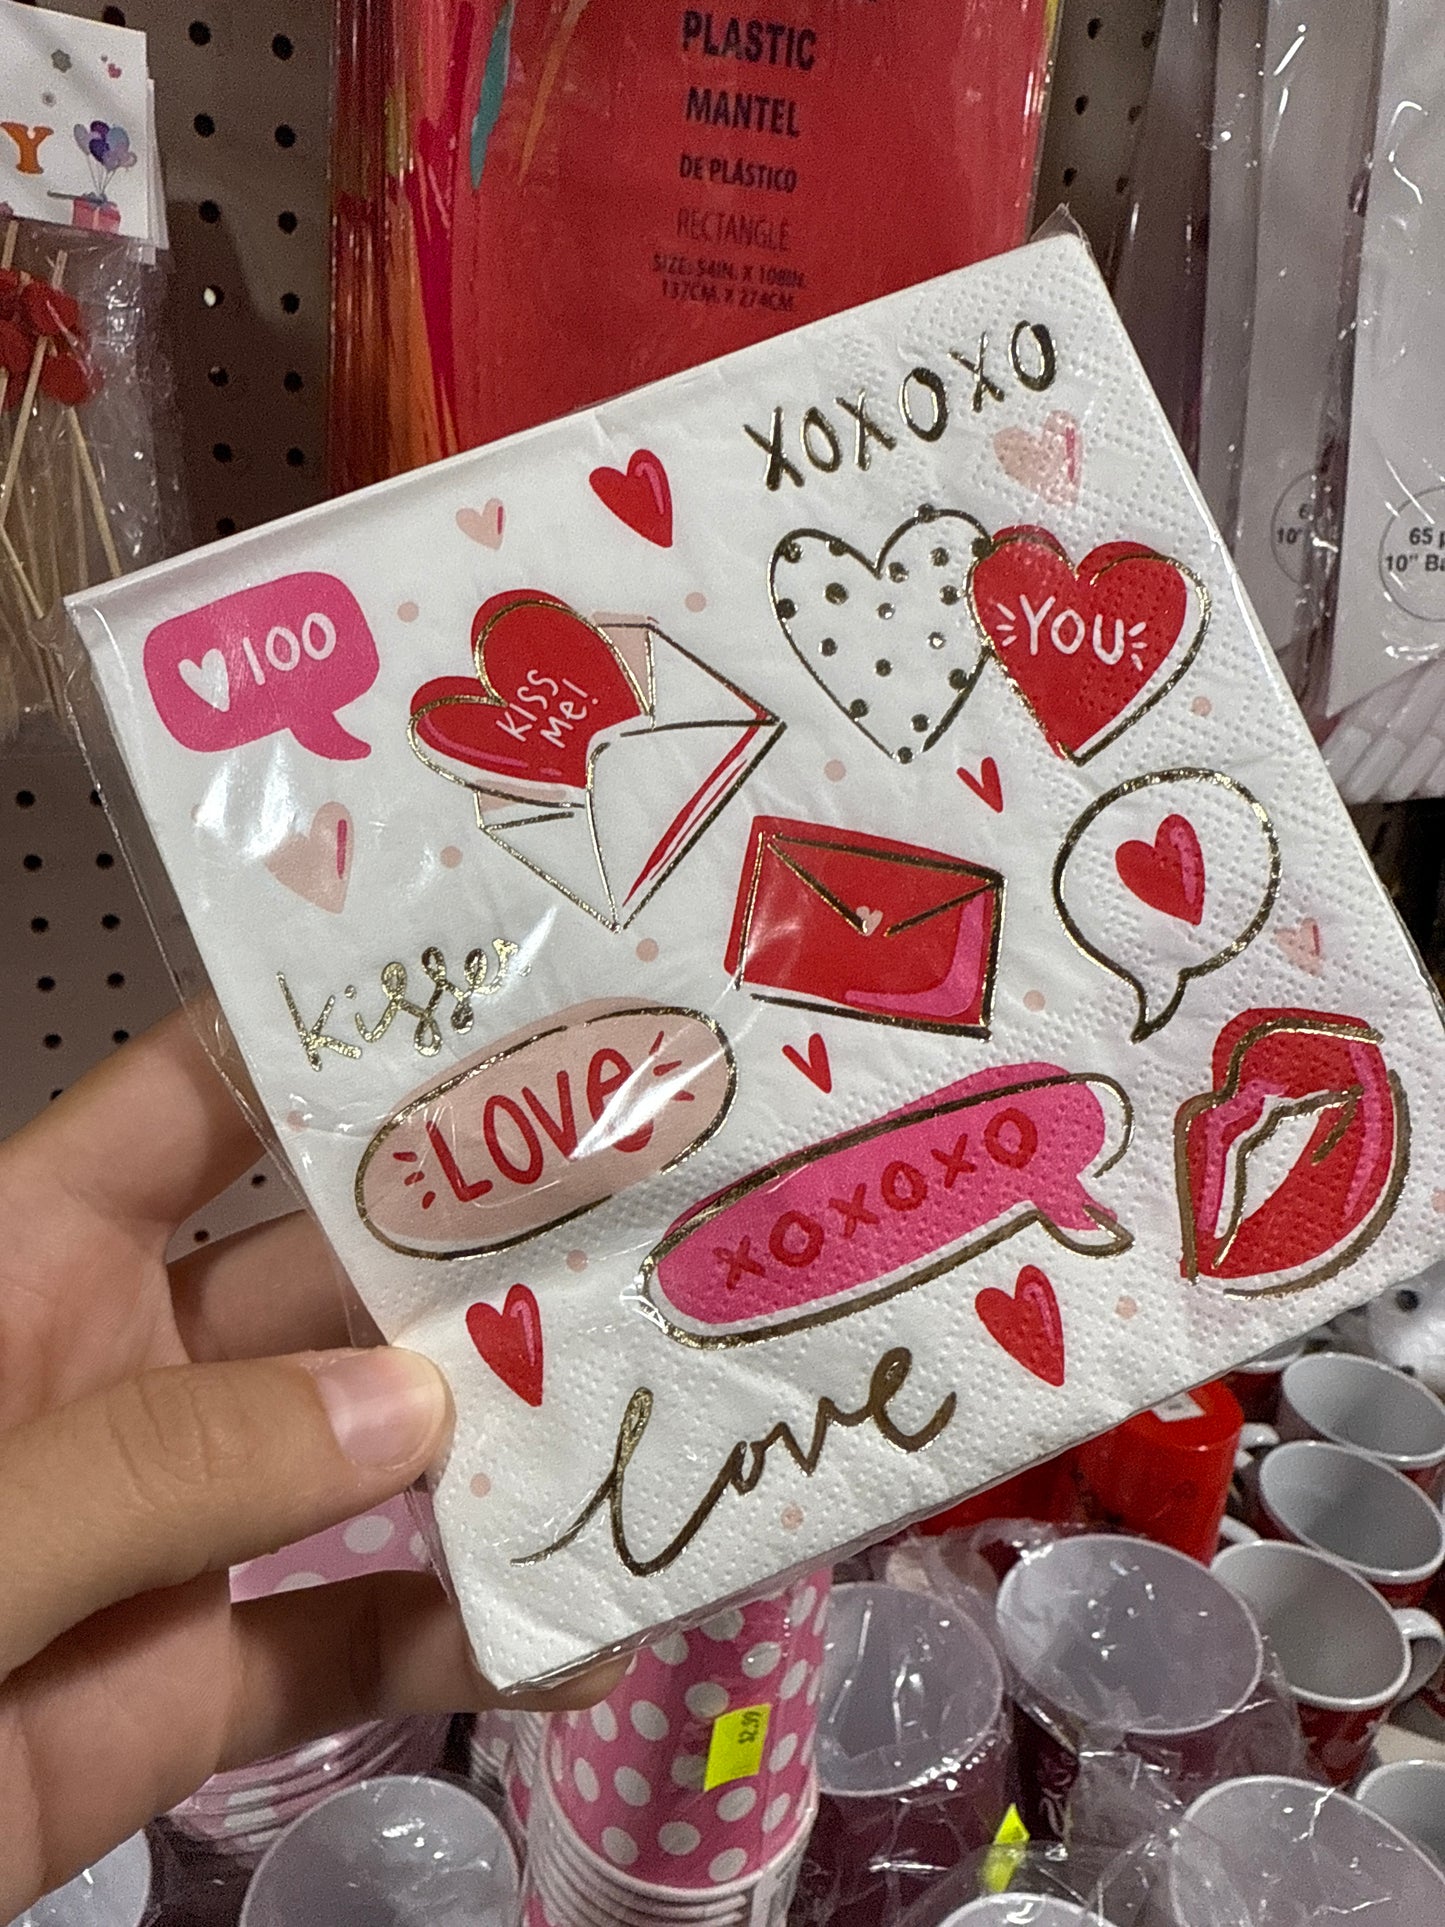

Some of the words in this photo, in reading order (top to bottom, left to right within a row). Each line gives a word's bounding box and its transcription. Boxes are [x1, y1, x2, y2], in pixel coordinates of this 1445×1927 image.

[682, 9, 816, 71] PLASTIC
[686, 86, 800, 138] MANTEL
[679, 153, 703, 181] DE
[709, 156, 798, 194] PLÁSTICO
[676, 206, 792, 252] RECTANGLE
[1408, 526, 1434, 546] 65
[242, 611, 338, 687] 100
[1018, 593, 1125, 666] YOU
[495, 669, 560, 743] KISS
